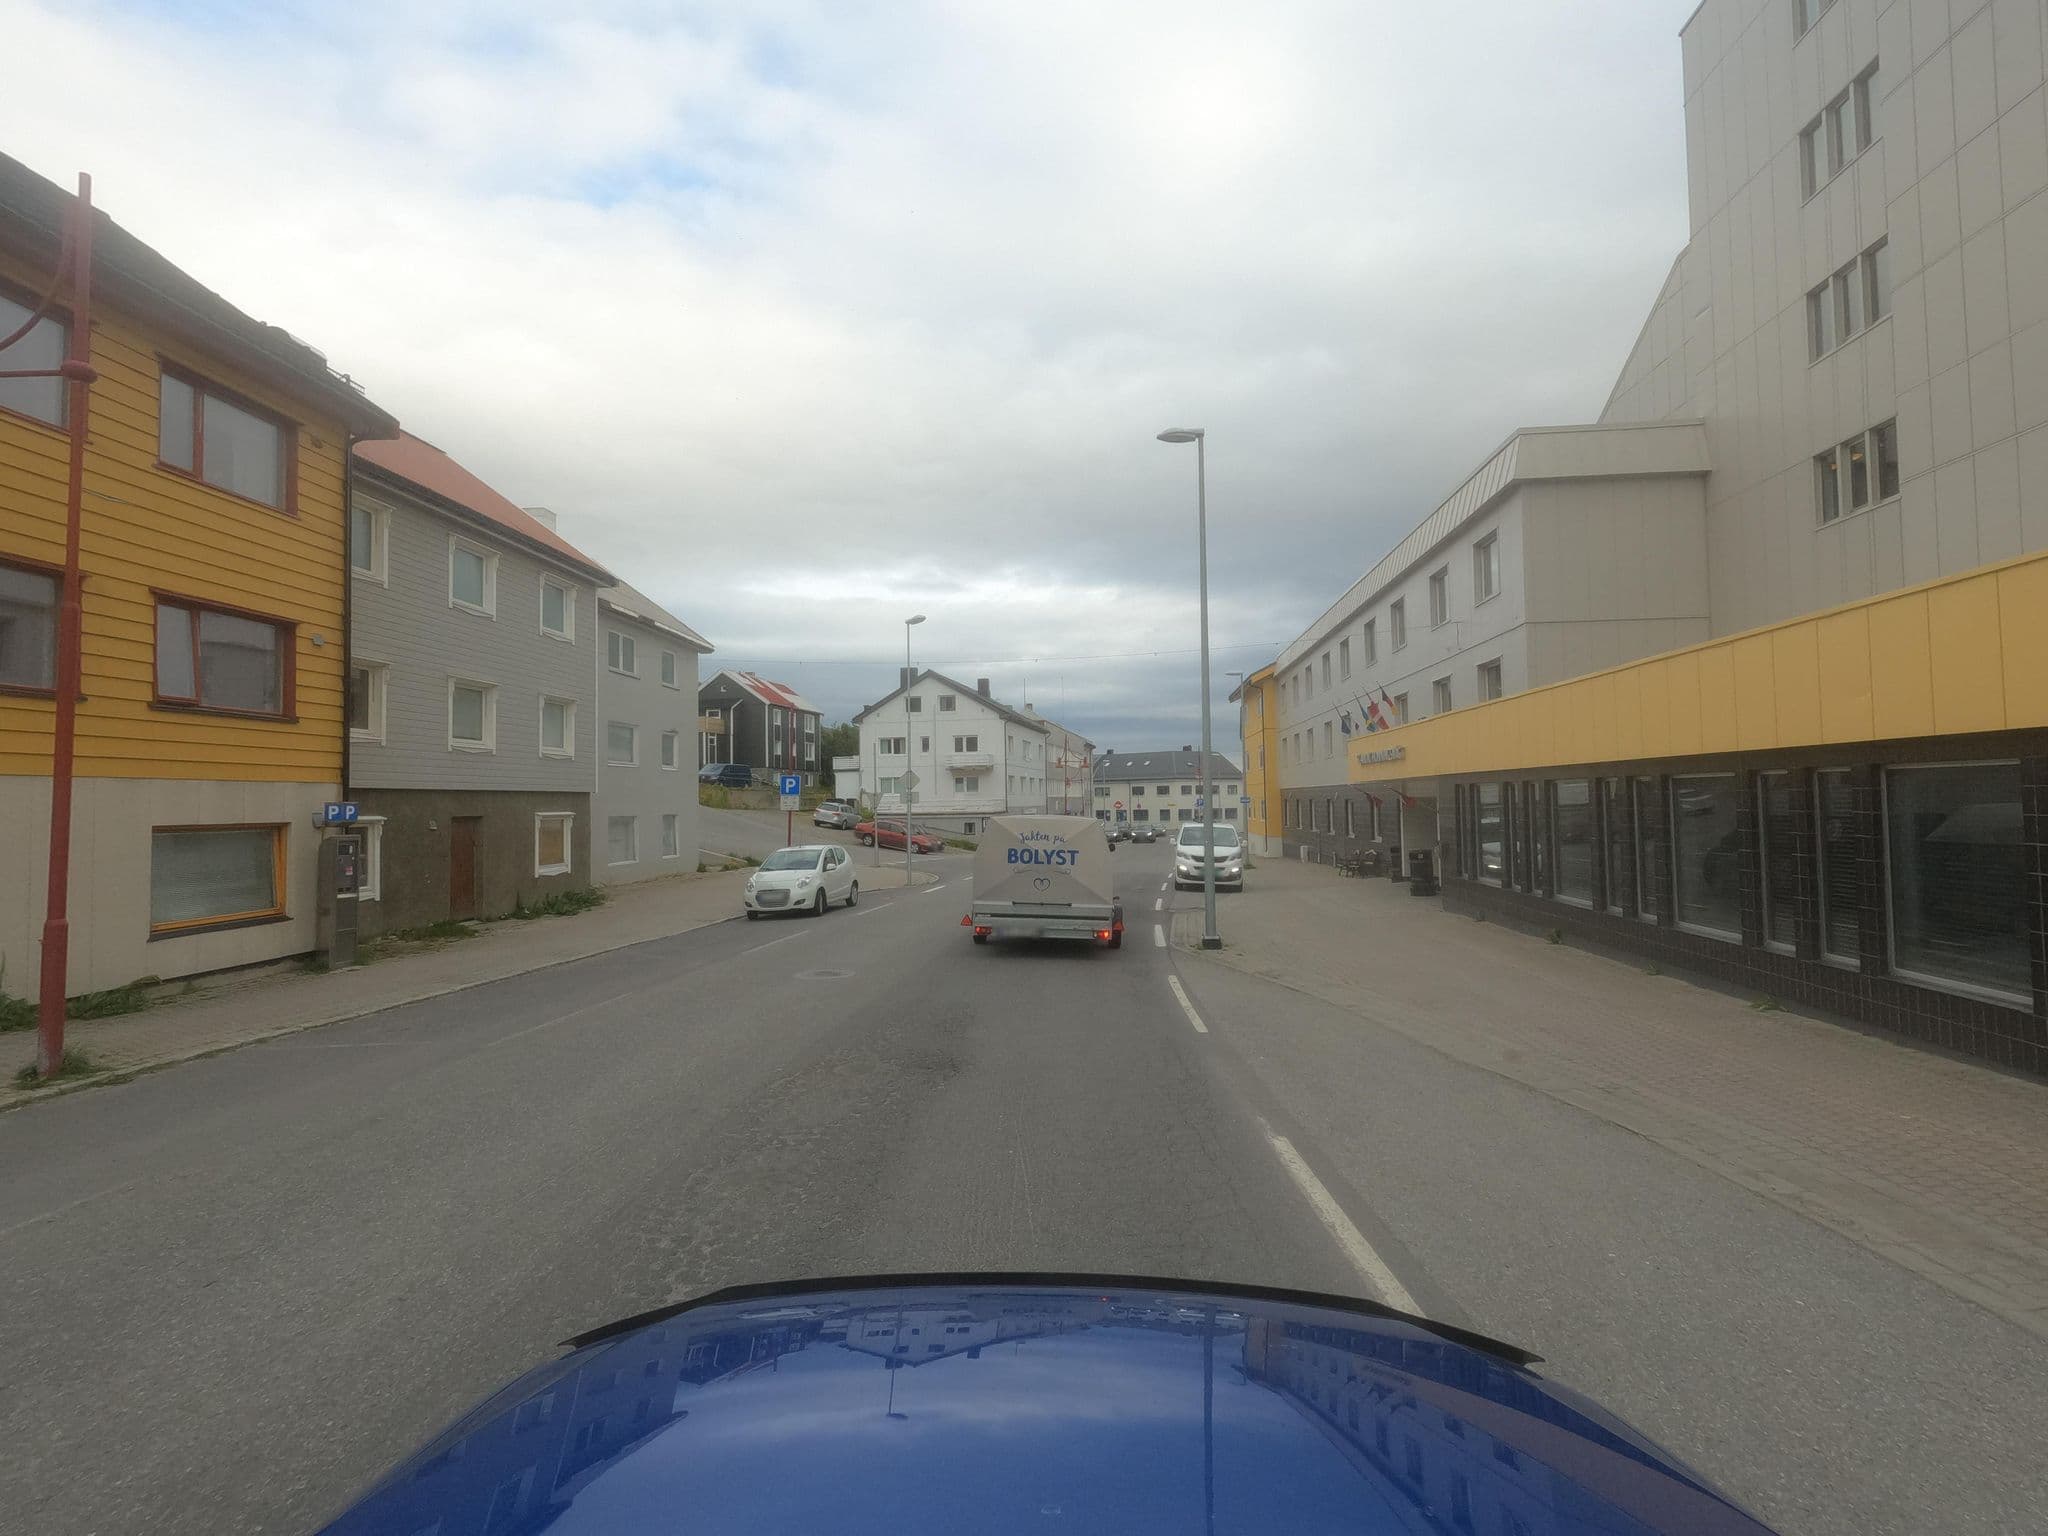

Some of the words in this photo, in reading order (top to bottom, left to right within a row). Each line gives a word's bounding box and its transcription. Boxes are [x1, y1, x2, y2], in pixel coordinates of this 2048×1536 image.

[785, 778, 796, 793] P
[328, 806, 339, 819] P
[346, 806, 355, 819] P
[1007, 848, 1079, 866] BOLYST
